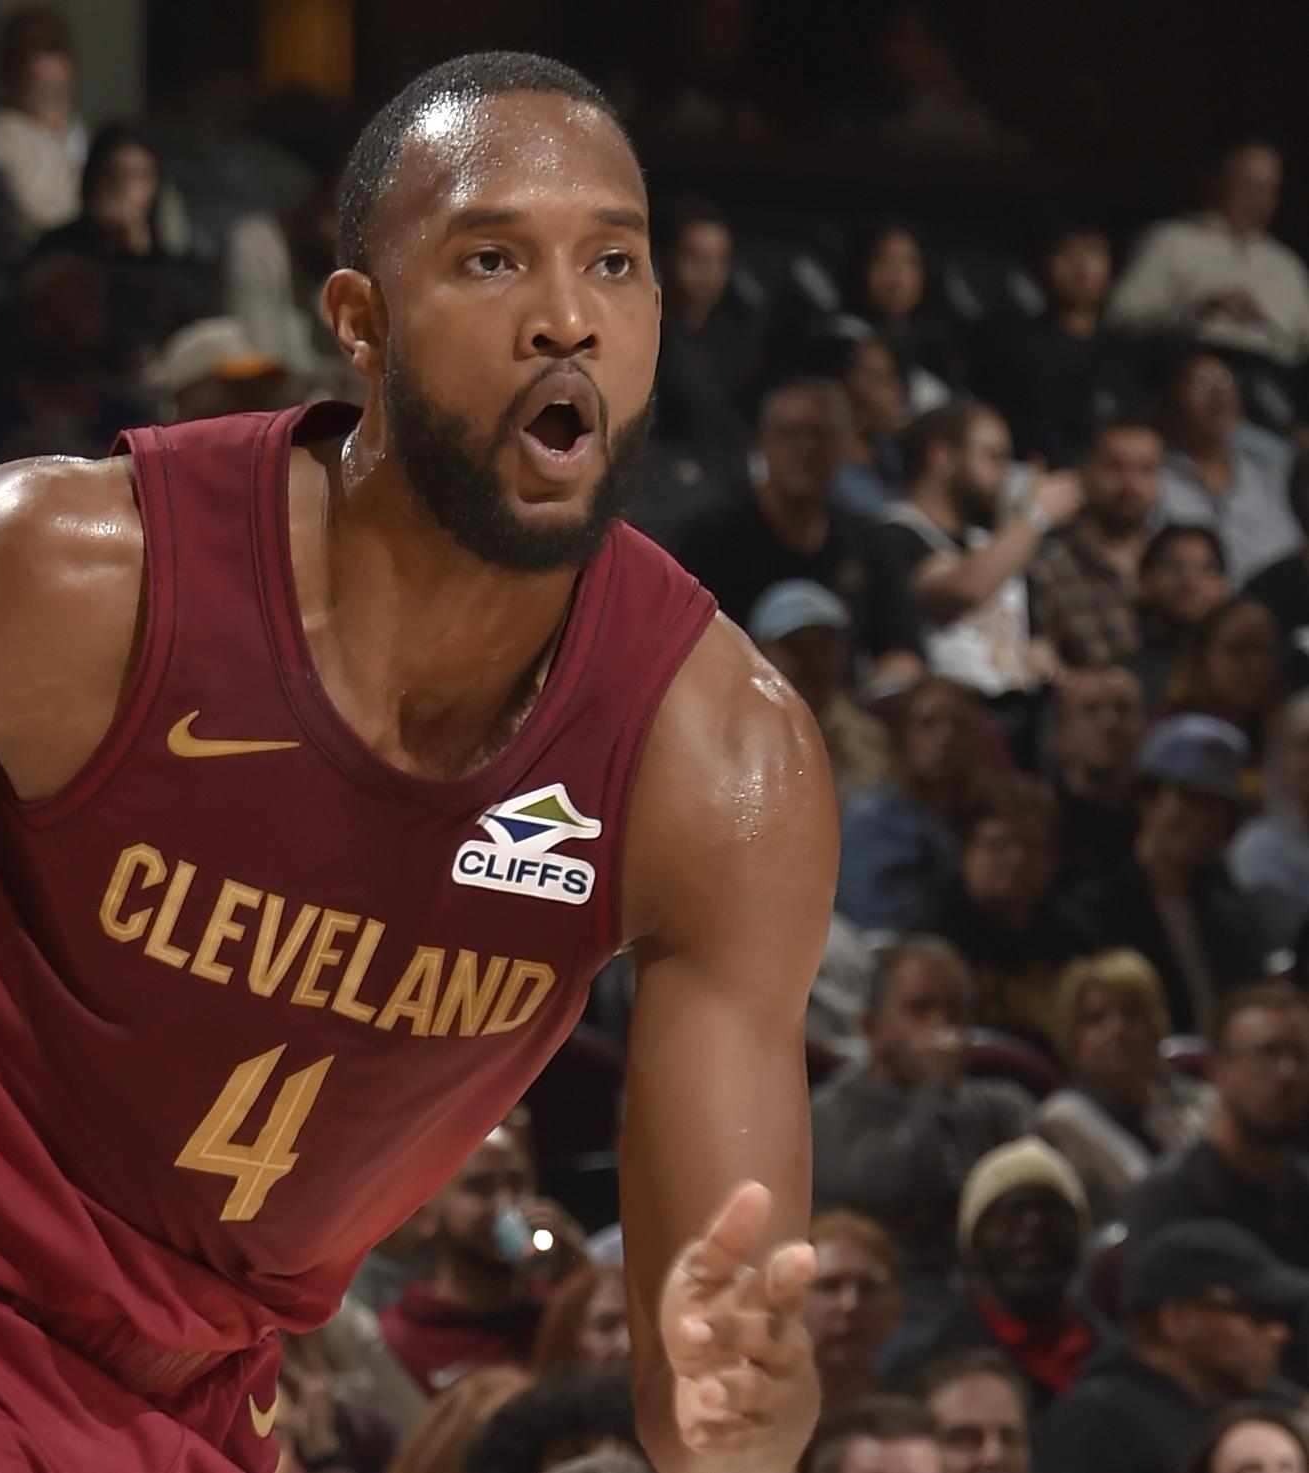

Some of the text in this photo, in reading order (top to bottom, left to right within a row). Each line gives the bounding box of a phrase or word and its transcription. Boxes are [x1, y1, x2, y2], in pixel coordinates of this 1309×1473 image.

[98, 842, 558, 1037] CLEVELAND
[459, 850, 589, 895] CLIFFS
[173, 1043, 335, 1222] 4
